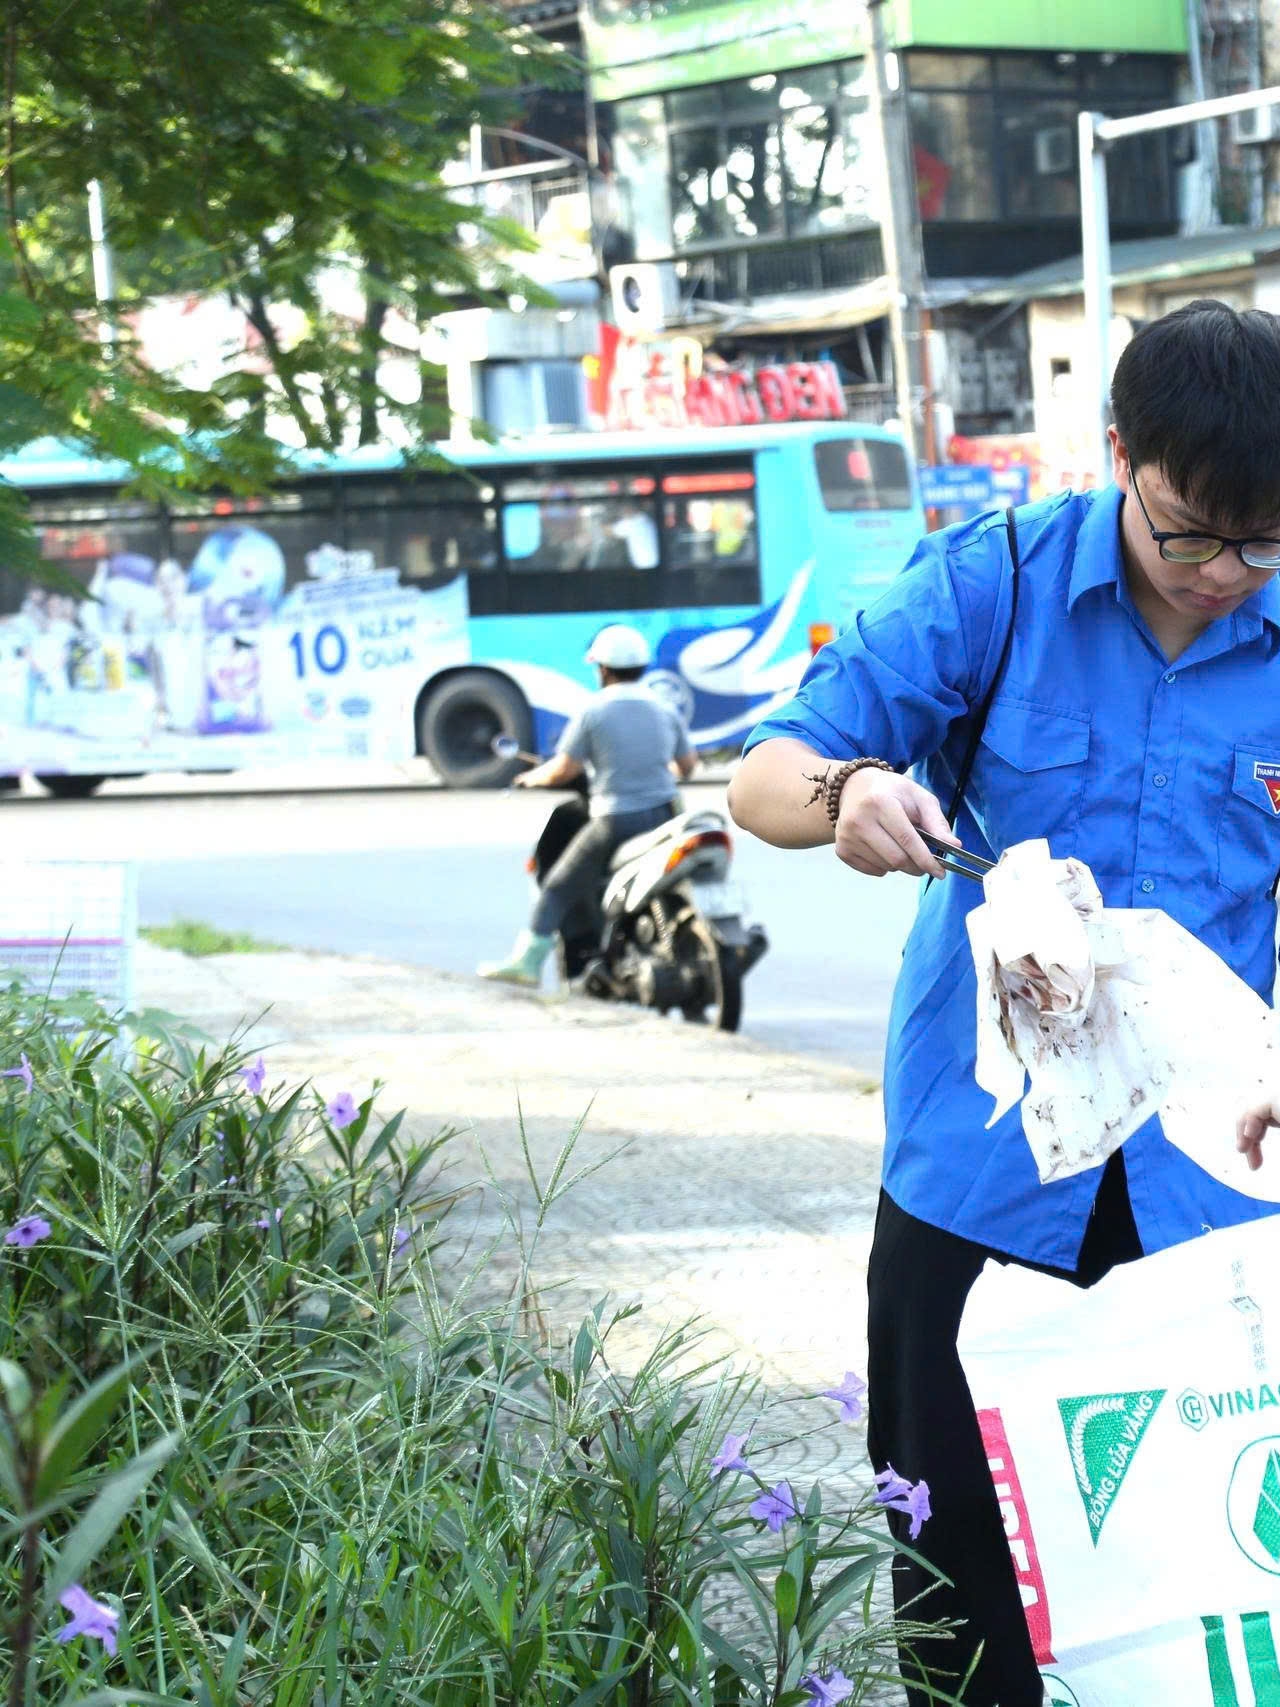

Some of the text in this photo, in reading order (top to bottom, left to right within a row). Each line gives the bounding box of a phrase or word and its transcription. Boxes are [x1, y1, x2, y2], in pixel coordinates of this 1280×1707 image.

[290, 624, 348, 679] 10
[1089, 1393, 1154, 1528] BÔNG LÚA VÀNG
